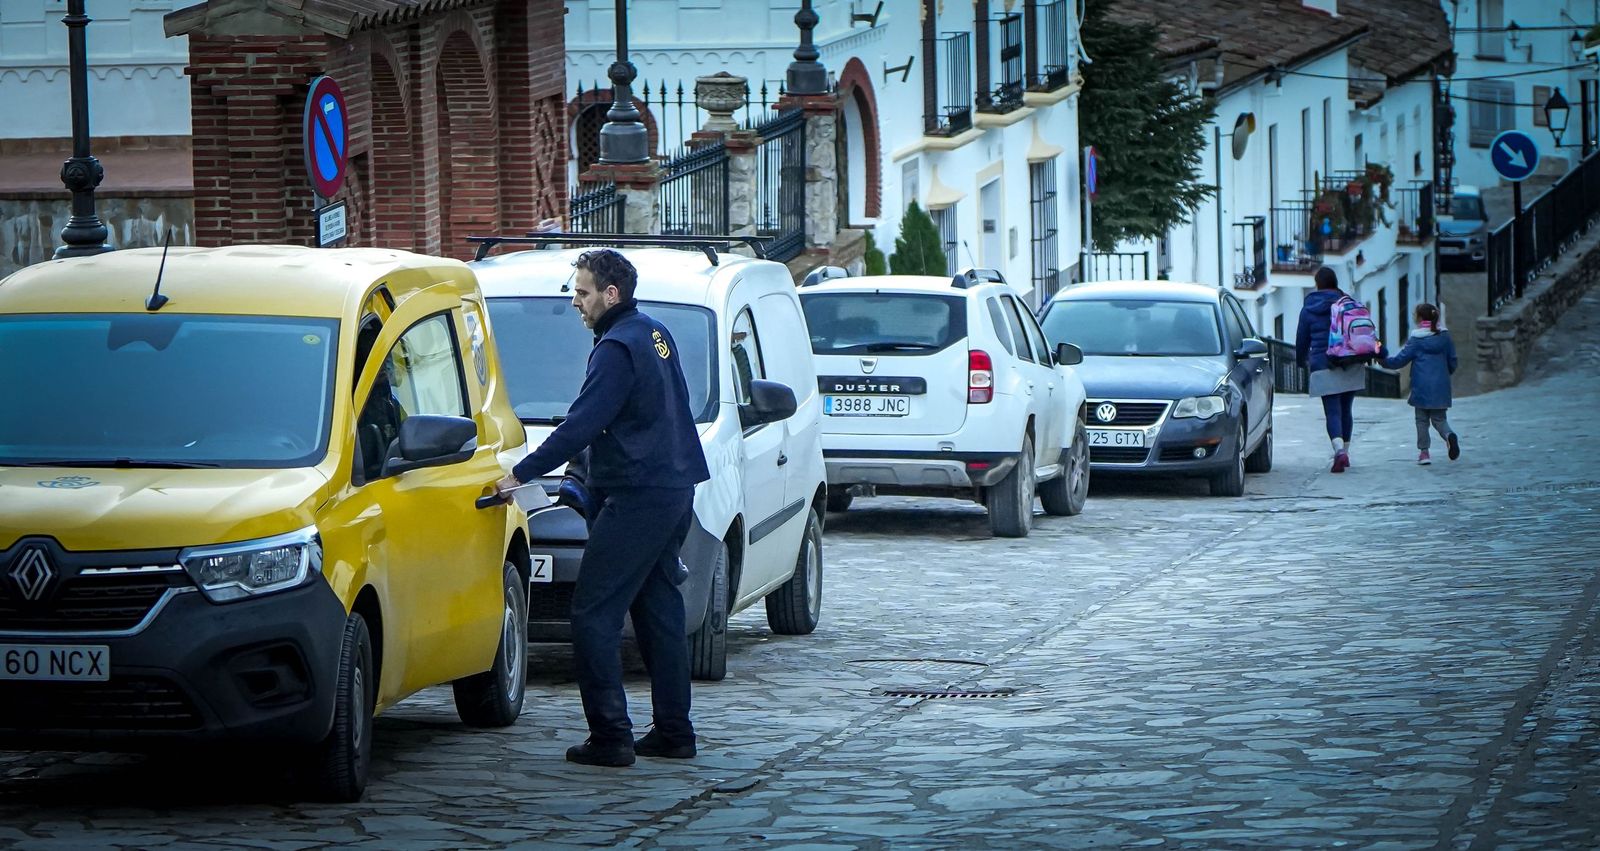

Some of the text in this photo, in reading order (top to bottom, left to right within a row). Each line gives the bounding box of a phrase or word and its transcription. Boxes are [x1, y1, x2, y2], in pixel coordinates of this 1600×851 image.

[835, 384, 900, 392] DUSTER
[835, 398, 905, 412] 3988 JNC
[1087, 432, 1140, 445] 125 GTX
[529, 558, 546, 578] Z
[5, 649, 103, 676] 60 NCX
